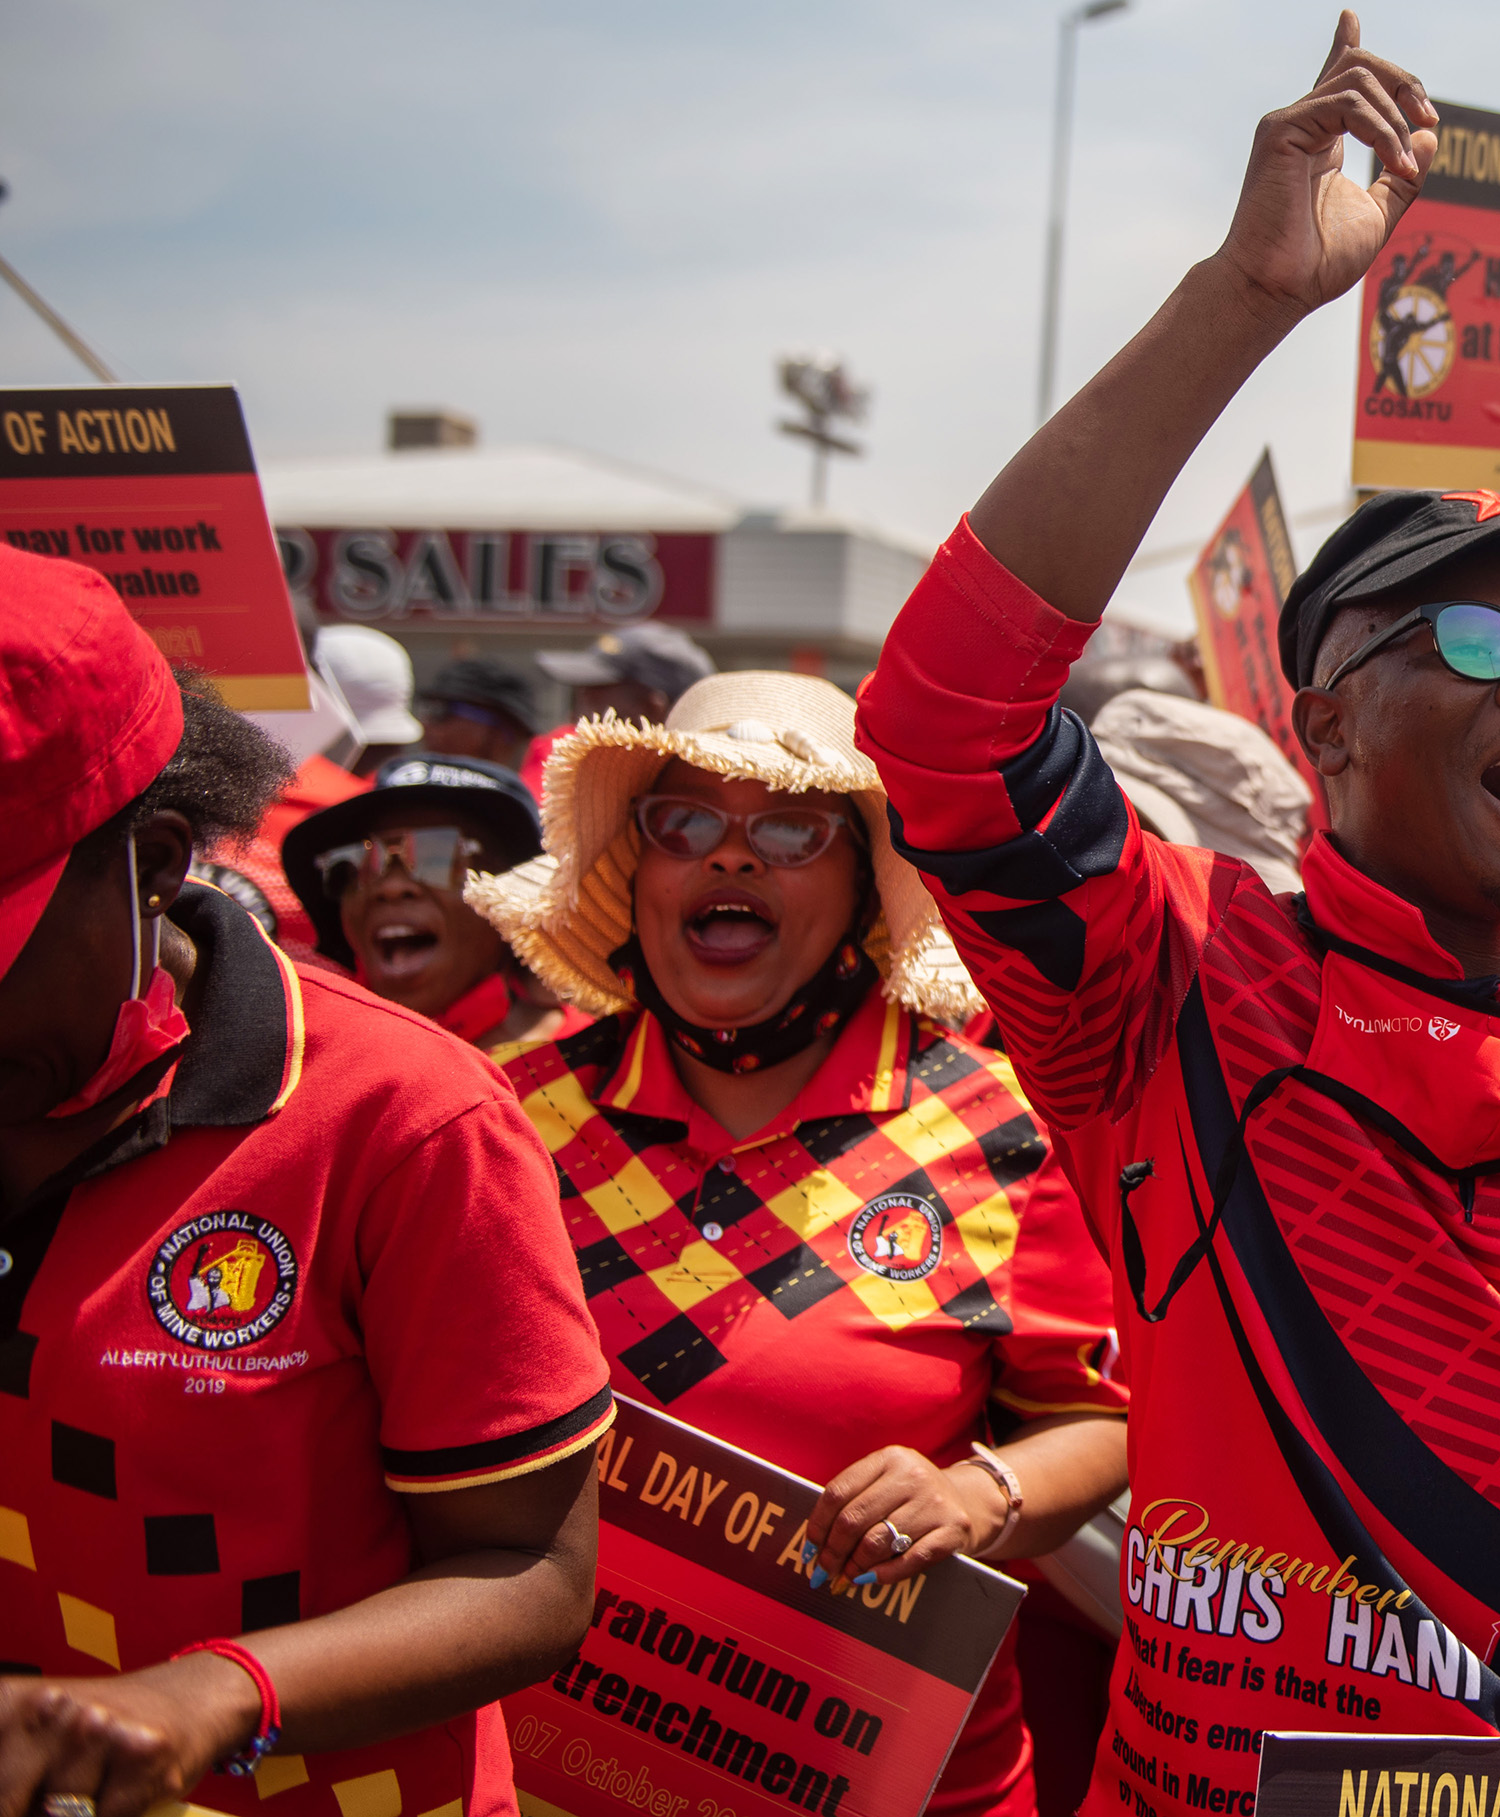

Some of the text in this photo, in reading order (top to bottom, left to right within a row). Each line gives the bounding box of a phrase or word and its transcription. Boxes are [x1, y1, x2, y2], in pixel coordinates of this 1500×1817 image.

[1461, 322, 1493, 361] at
[4, 408, 177, 455] OF ACTION
[1364, 396, 1452, 421] COSATU
[6, 520, 222, 556] pay for work
[328, 527, 664, 624] SALES
[159, 1213, 295, 1278] NATIONAL UNION
[856, 1197, 940, 1242] NATIONAL UNION
[852, 1240, 938, 1280] OF MINE WORKERS
[151, 1275, 290, 1348] OF MINE WORKERS
[184, 1377, 227, 1394] 2019
[639, 1450, 728, 1527] DAY
[724, 1491, 785, 1552] OF
[1125, 1525, 1482, 1701] CHRIS HANI
[1162, 1641, 1172, 1674] I
[1177, 1646, 1234, 1687] fear
[1240, 1657, 1265, 1692] is
[1274, 1665, 1328, 1709] that
[1336, 1684, 1381, 1721] the
[813, 1695, 883, 1756] on
[513, 1714, 689, 1817] 07 October
[1112, 1729, 1157, 1787] around
[1162, 1762, 1180, 1799] in
